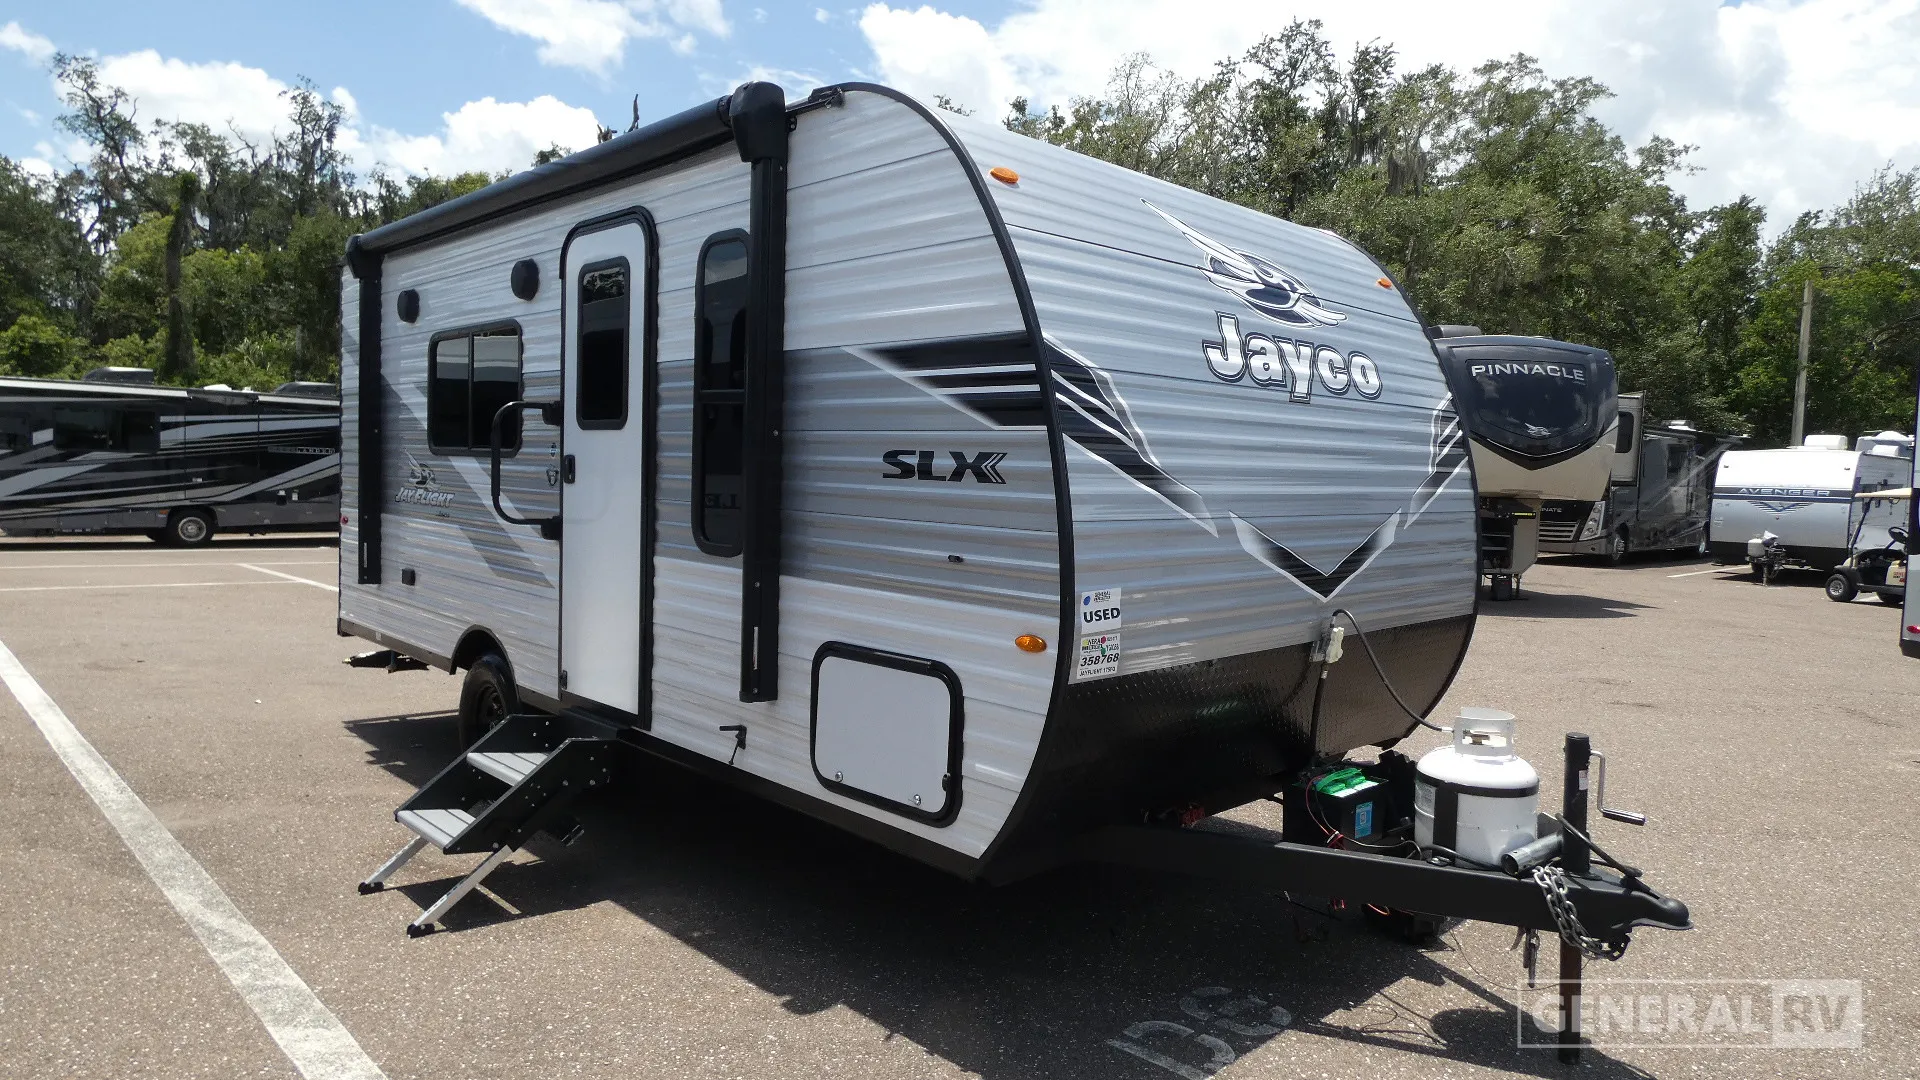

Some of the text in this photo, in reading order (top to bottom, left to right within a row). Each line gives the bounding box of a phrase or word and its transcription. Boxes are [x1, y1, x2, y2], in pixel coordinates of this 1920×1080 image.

[1202, 310, 1383, 404] Jayco
[1471, 363, 1585, 381] PINNACLE
[882, 449, 1008, 485] SLX
[1738, 487, 1831, 497] AVENGER
[1083, 607, 1121, 624] USED
[1080, 652, 1120, 667] 358768
